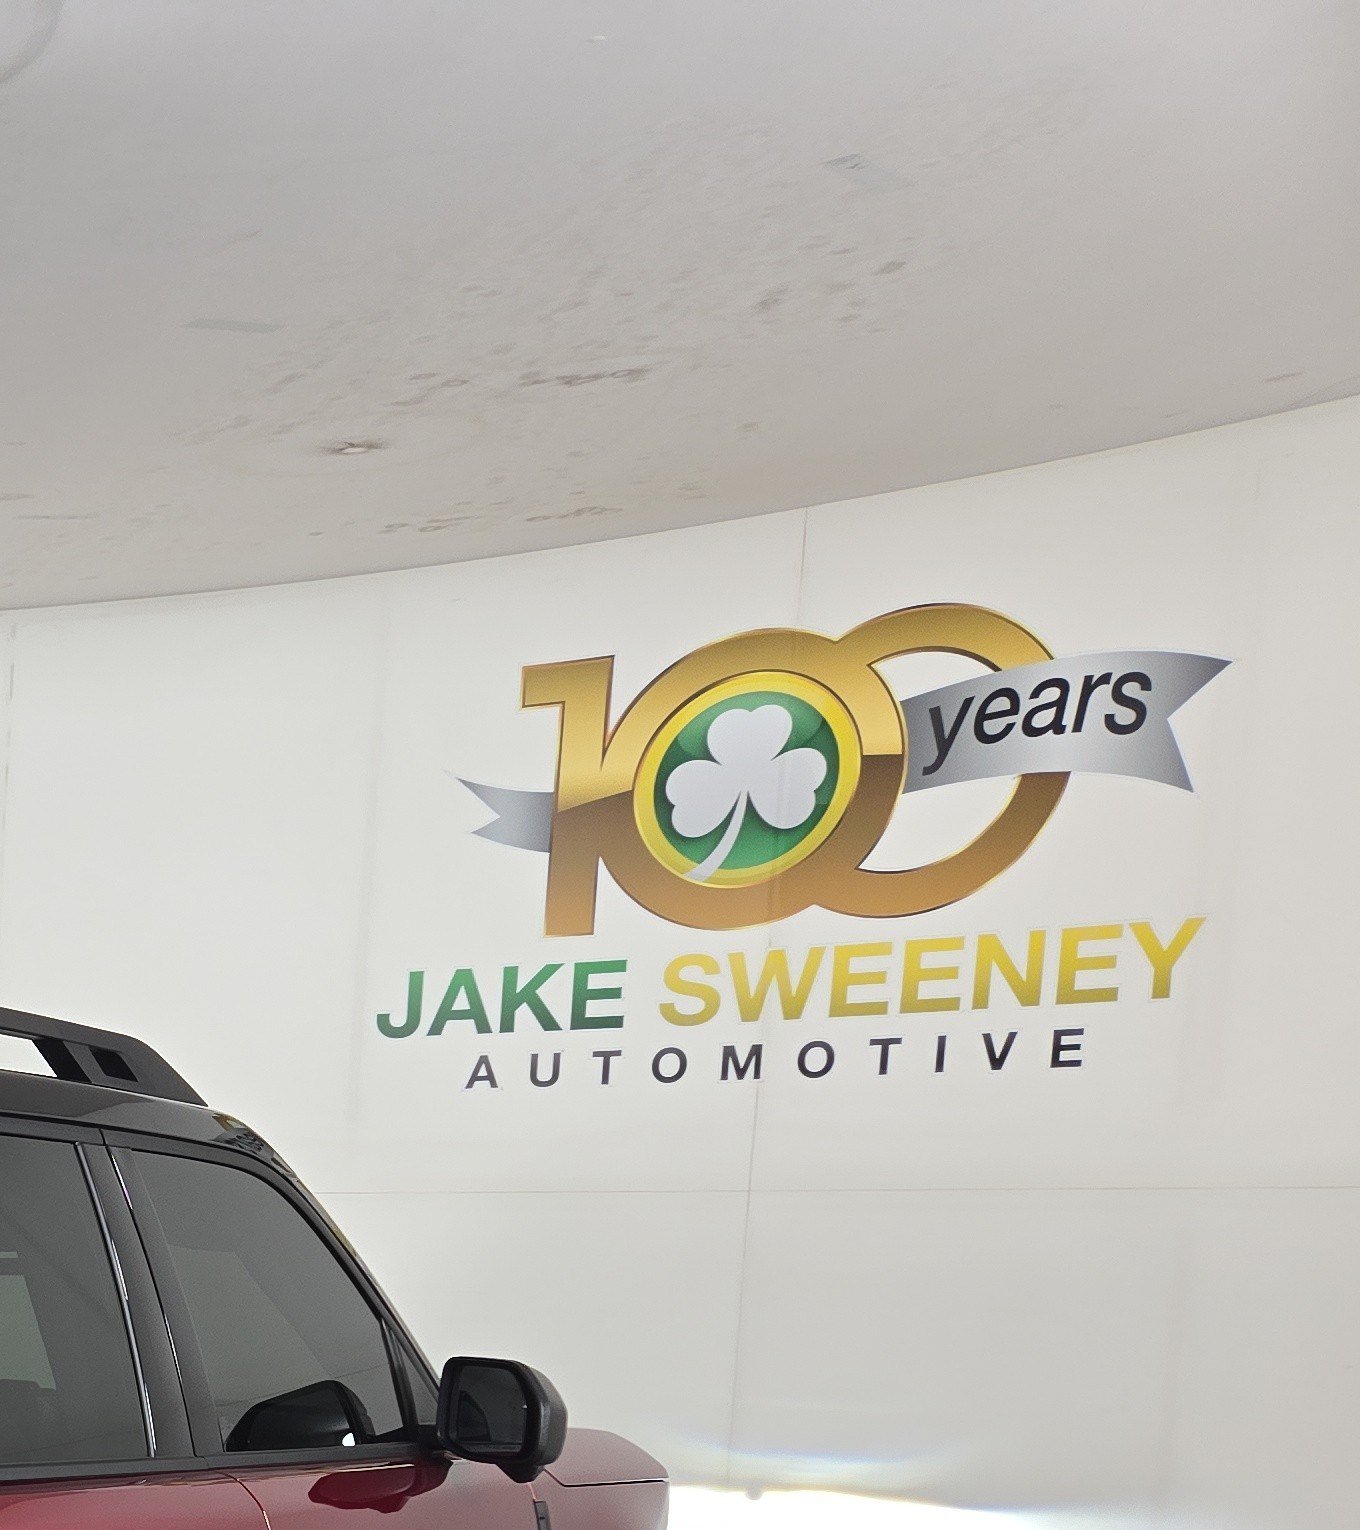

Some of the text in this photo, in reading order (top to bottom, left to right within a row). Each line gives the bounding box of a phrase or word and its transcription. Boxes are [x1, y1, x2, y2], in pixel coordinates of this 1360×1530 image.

[519, 602, 1153, 938] 100 years
[376, 917, 1208, 1041] JAKE SWEENEY
[465, 1028, 1086, 1091] AUTOMOTIVE
